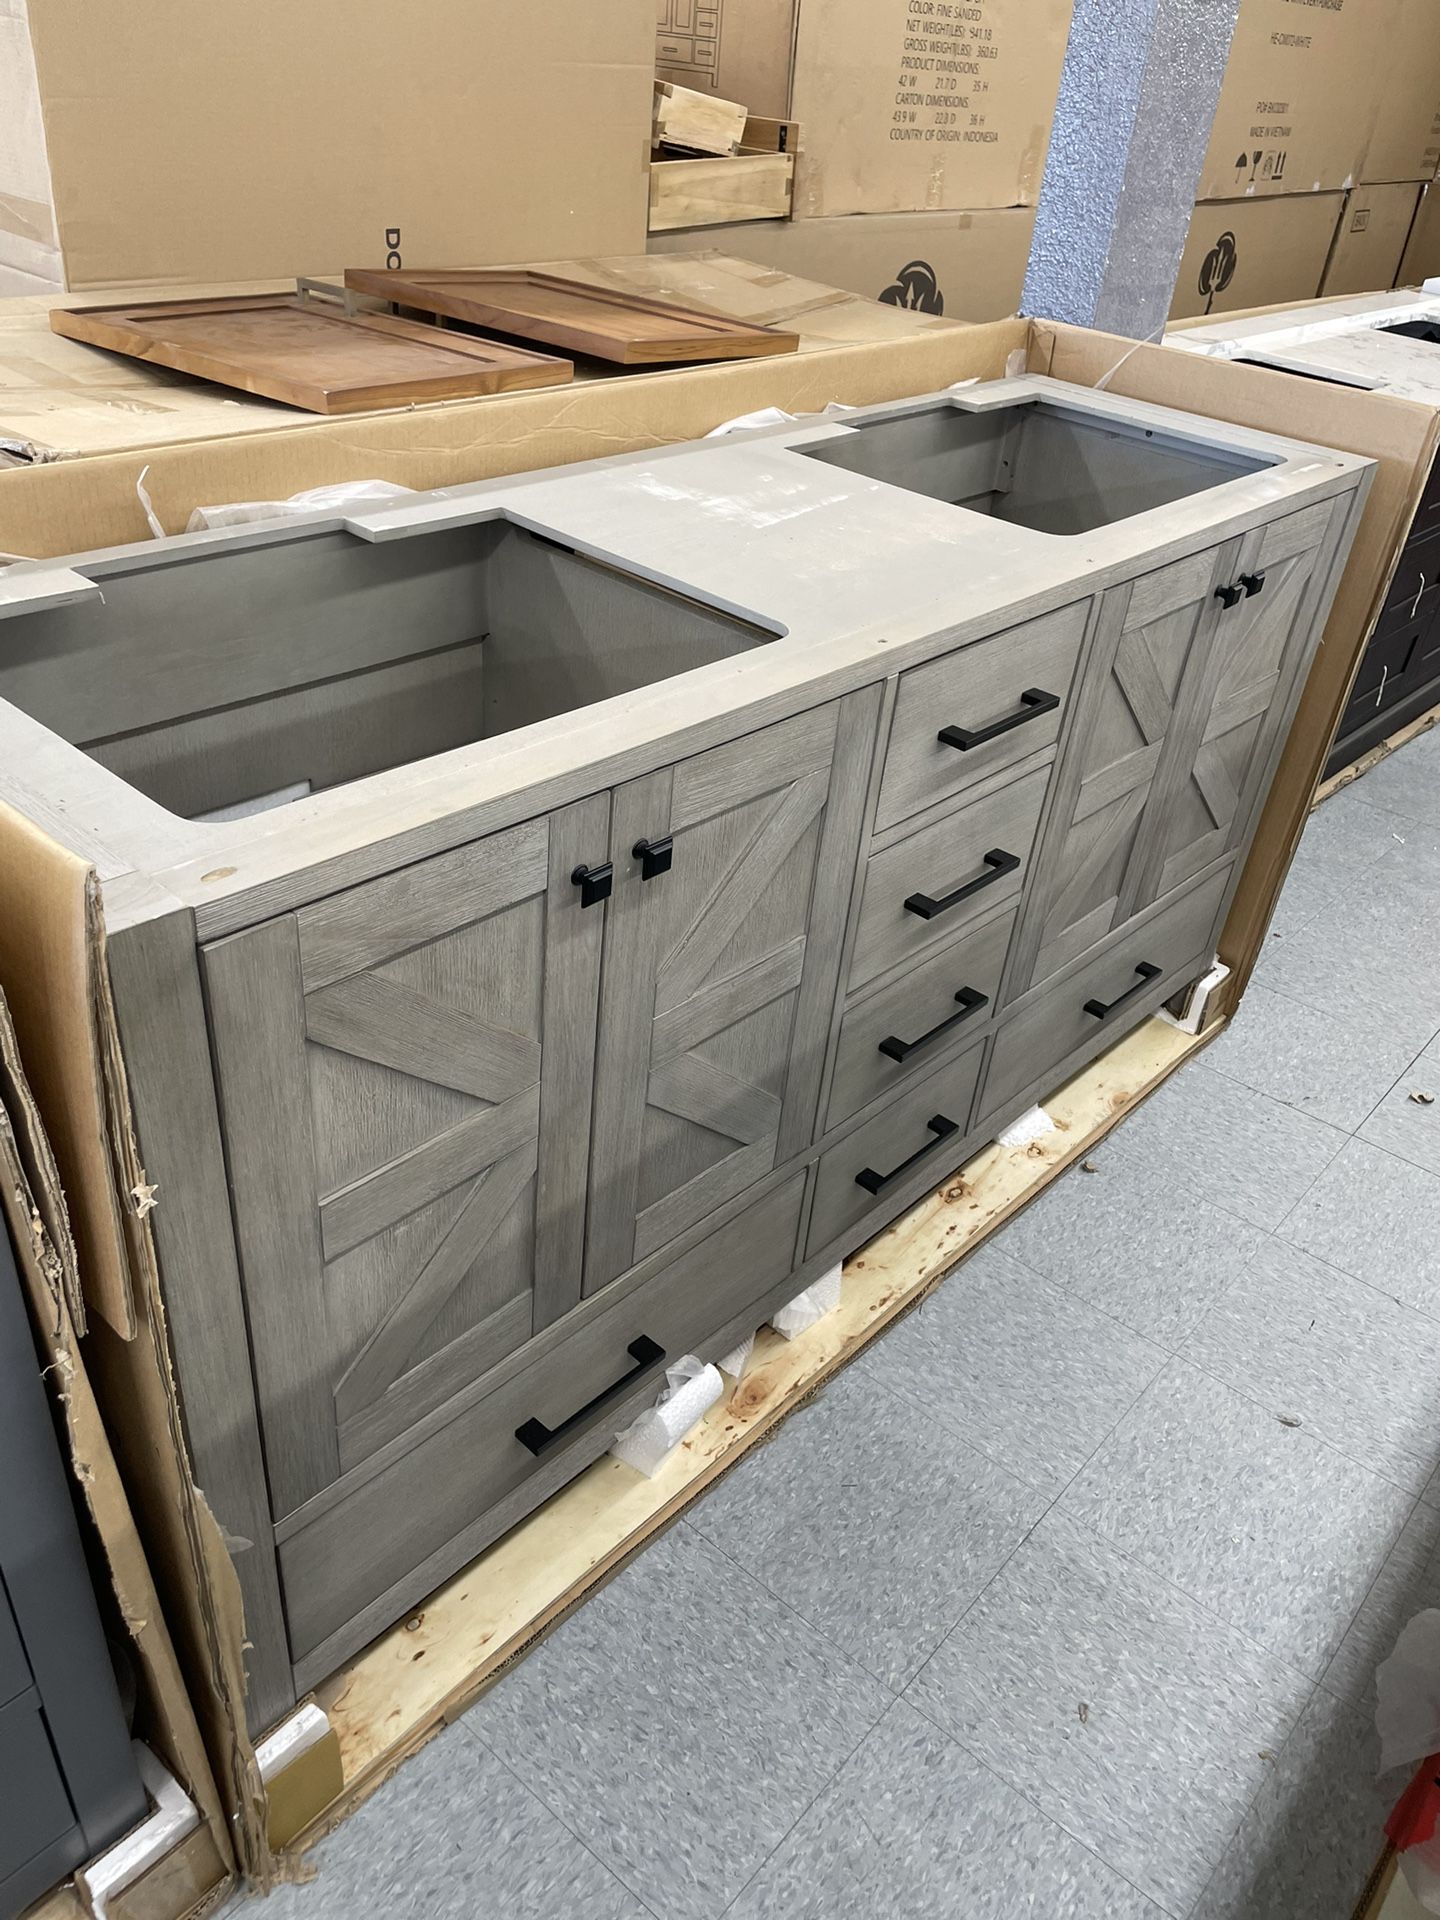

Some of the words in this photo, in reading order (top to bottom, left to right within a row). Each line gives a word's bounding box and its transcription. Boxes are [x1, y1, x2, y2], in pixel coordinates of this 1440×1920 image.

[937, 4, 953, 18] FINE
[954, 6, 982, 21] SANDED
[906, 19, 921, 32] NET
[904, 38, 928, 52] GROSS
[901, 56, 935, 71] PRODUCT
[898, 74, 908, 87] 42
[908, 75, 917, 87] W
[950, 78, 957, 90] D
[972, 80, 981, 92] 35
[982, 81, 990, 92] H
[895, 92, 924, 106] CARTON
[908, 111, 917, 123] W
[949, 113, 957, 125] D
[979, 114, 986, 126] H
[889, 128, 924, 141] COUNTRY
[925, 129, 935, 141] OF
[963, 130, 999, 143] INDONESIA
